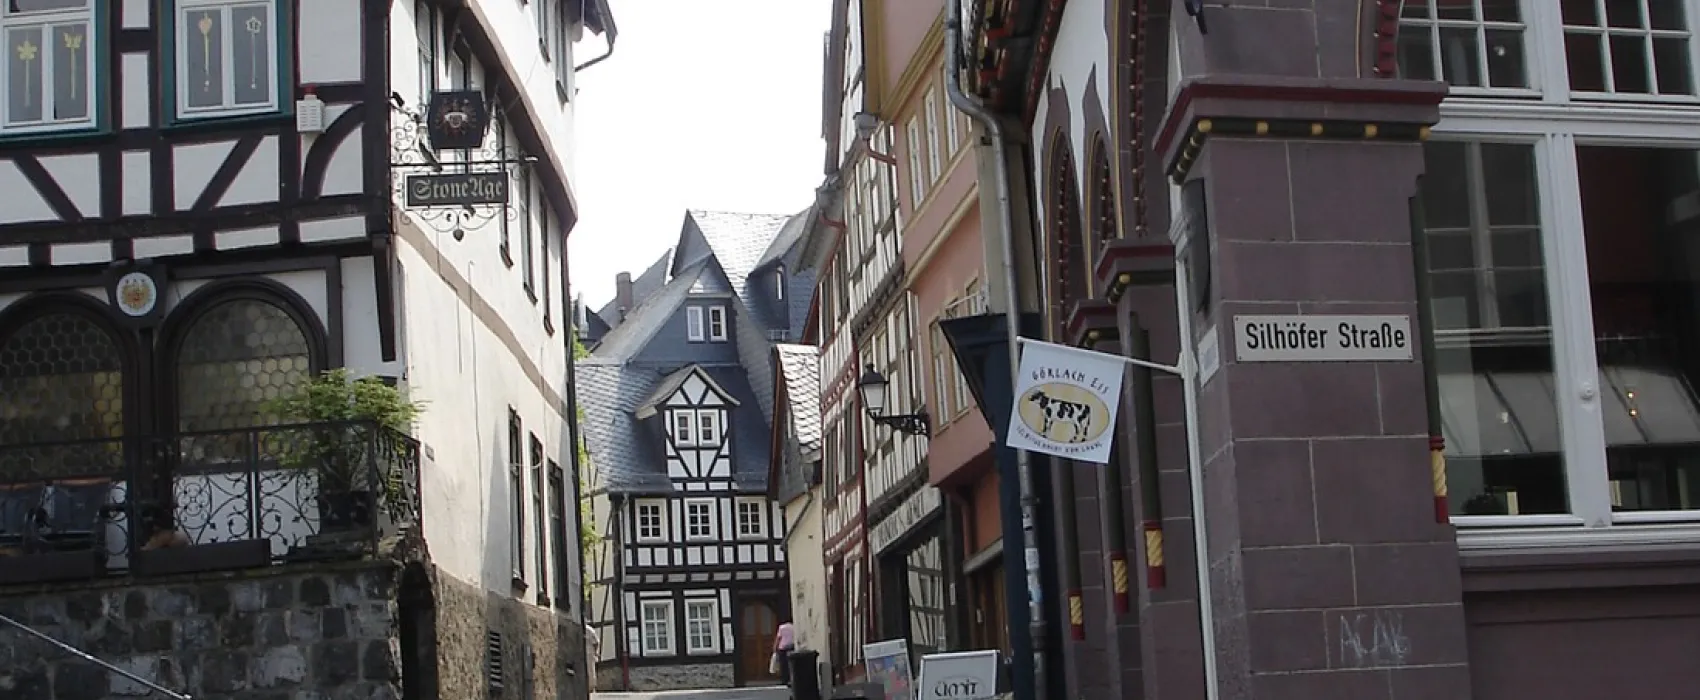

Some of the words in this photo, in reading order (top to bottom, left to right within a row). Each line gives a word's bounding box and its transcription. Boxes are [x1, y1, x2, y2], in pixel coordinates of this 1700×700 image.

[1245, 322, 1328, 349] Silhöfer
[1338, 322, 1405, 348] Straße
[1032, 365, 1085, 382] GÖRLACH
